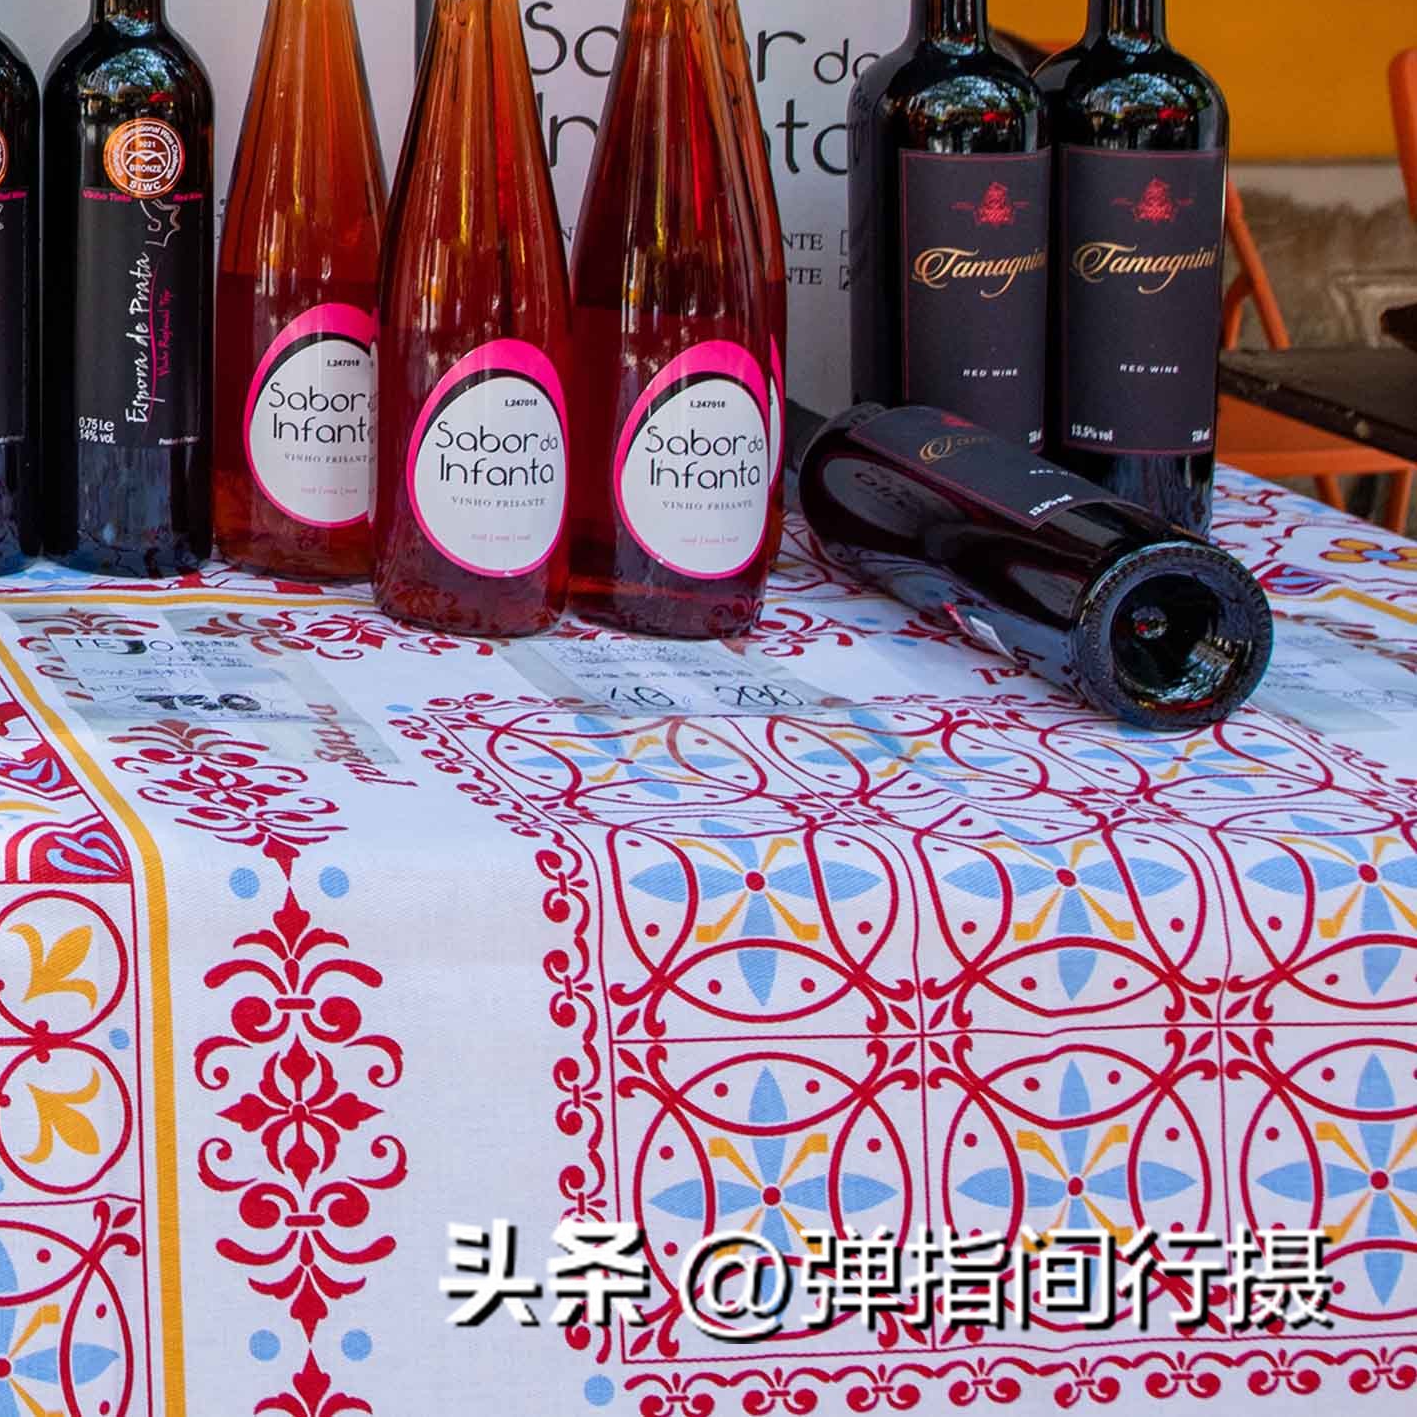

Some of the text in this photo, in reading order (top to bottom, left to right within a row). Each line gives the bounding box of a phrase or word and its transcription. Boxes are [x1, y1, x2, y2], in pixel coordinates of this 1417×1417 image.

[525, 1, 806, 82] Sar
[159, 126, 174, 145] Wine
[139, 140, 156, 148] 2021
[129, 164, 162, 173] BRONZE
[129, 180, 161, 191] SIWC
[125, 251, 165, 422] Espora de Prata
[963, 369, 1019, 377] RED WINE
[1120, 364, 1179, 374] RED WINE
[269, 382, 366, 412] Sabor
[79, 429, 98, 442] 14%
[435, 420, 539, 453] Sabor
[645, 425, 747, 456] Sabor
[284, 453, 321, 463] VINHO
[439, 453, 555, 487] Infanta
[650, 458, 761, 490] Infanta
[451, 496, 547, 508] VINHO FRISANTE
[661, 500, 753, 511] VINHO FRISANTE
